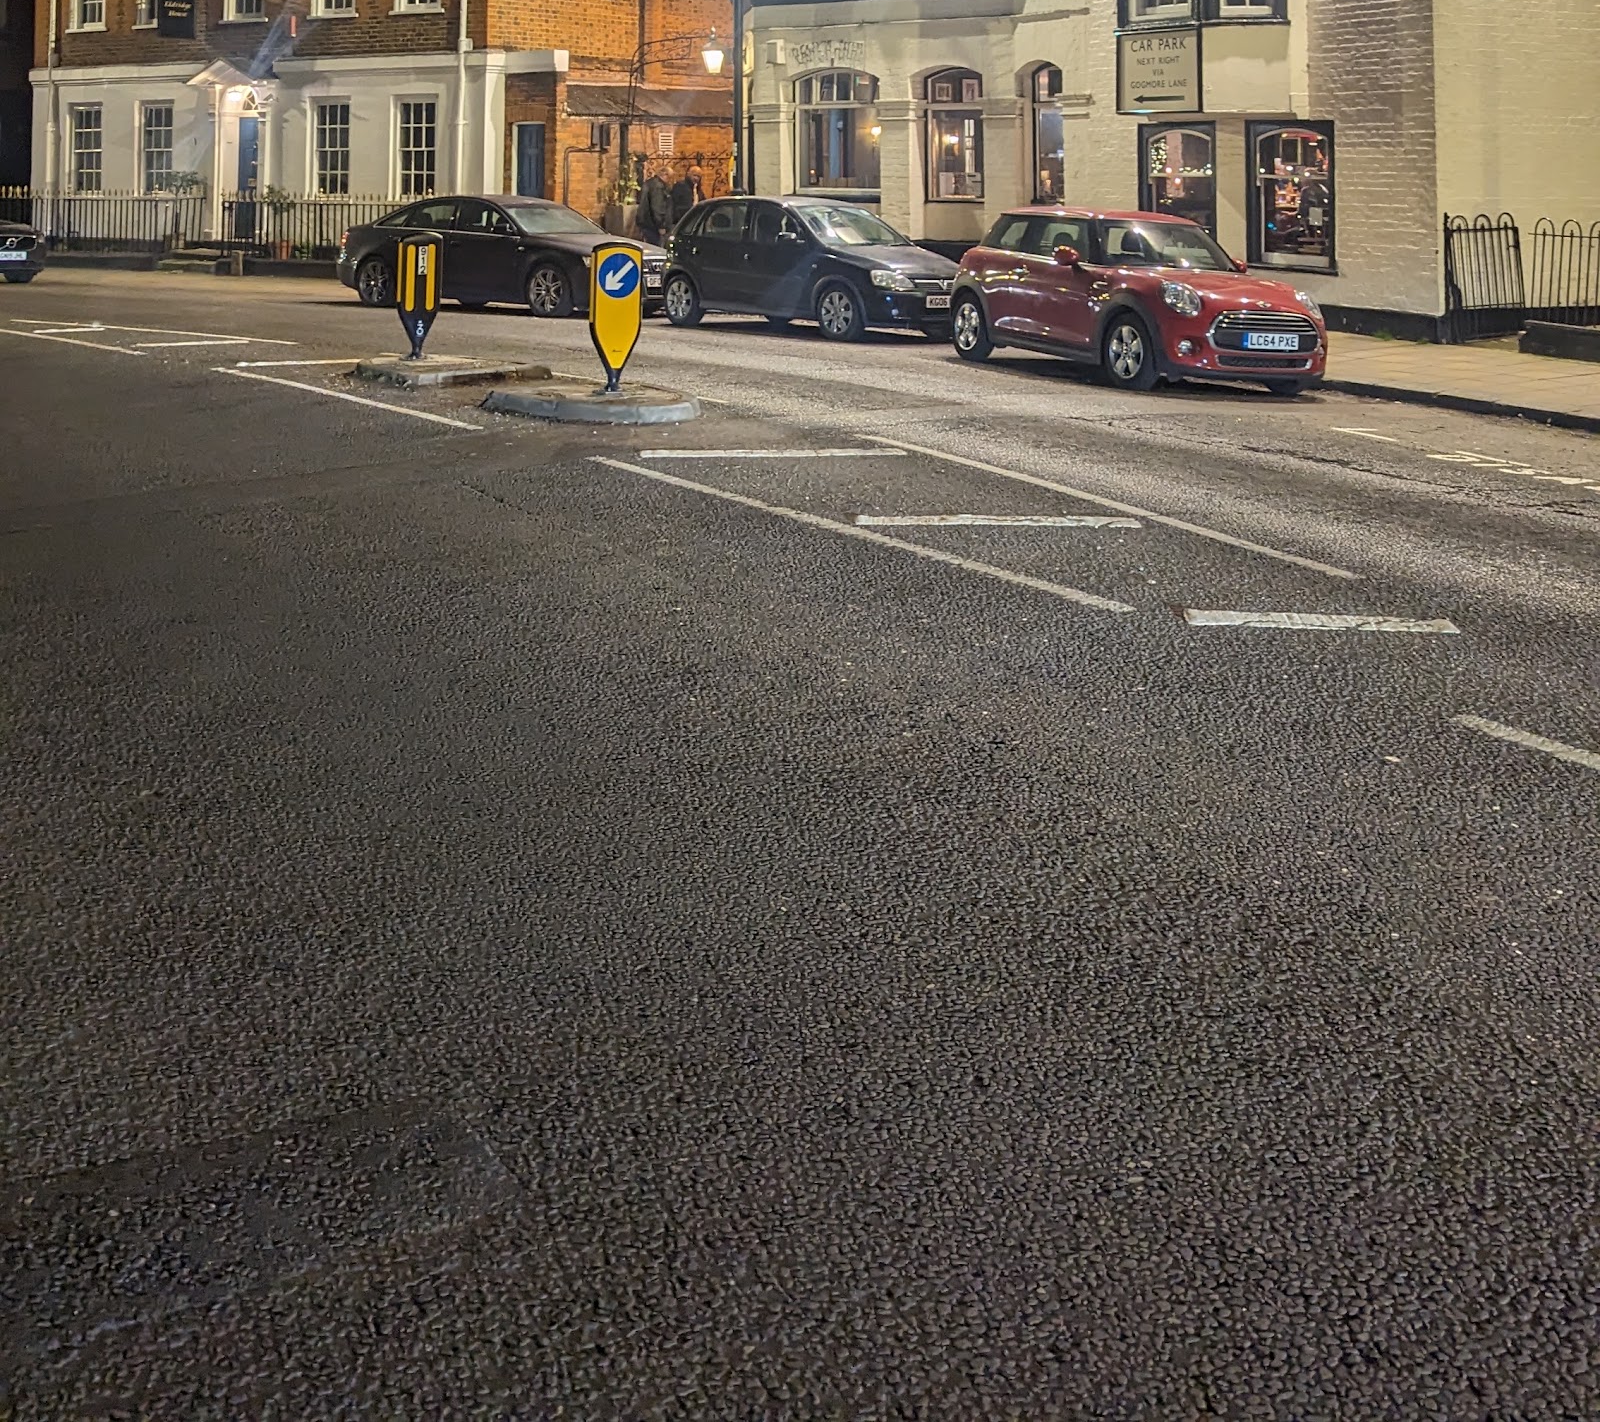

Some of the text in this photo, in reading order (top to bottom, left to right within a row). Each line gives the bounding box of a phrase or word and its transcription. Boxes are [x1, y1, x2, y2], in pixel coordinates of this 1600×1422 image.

[1130, 37, 1187, 53] CAR PARK
[1136, 55, 1180, 66] NEXT RIGHT
[1152, 68, 1165, 77] VIA
[1168, 78, 1188, 88] LANE
[1250, 335, 1297, 348] LC64 PXE
